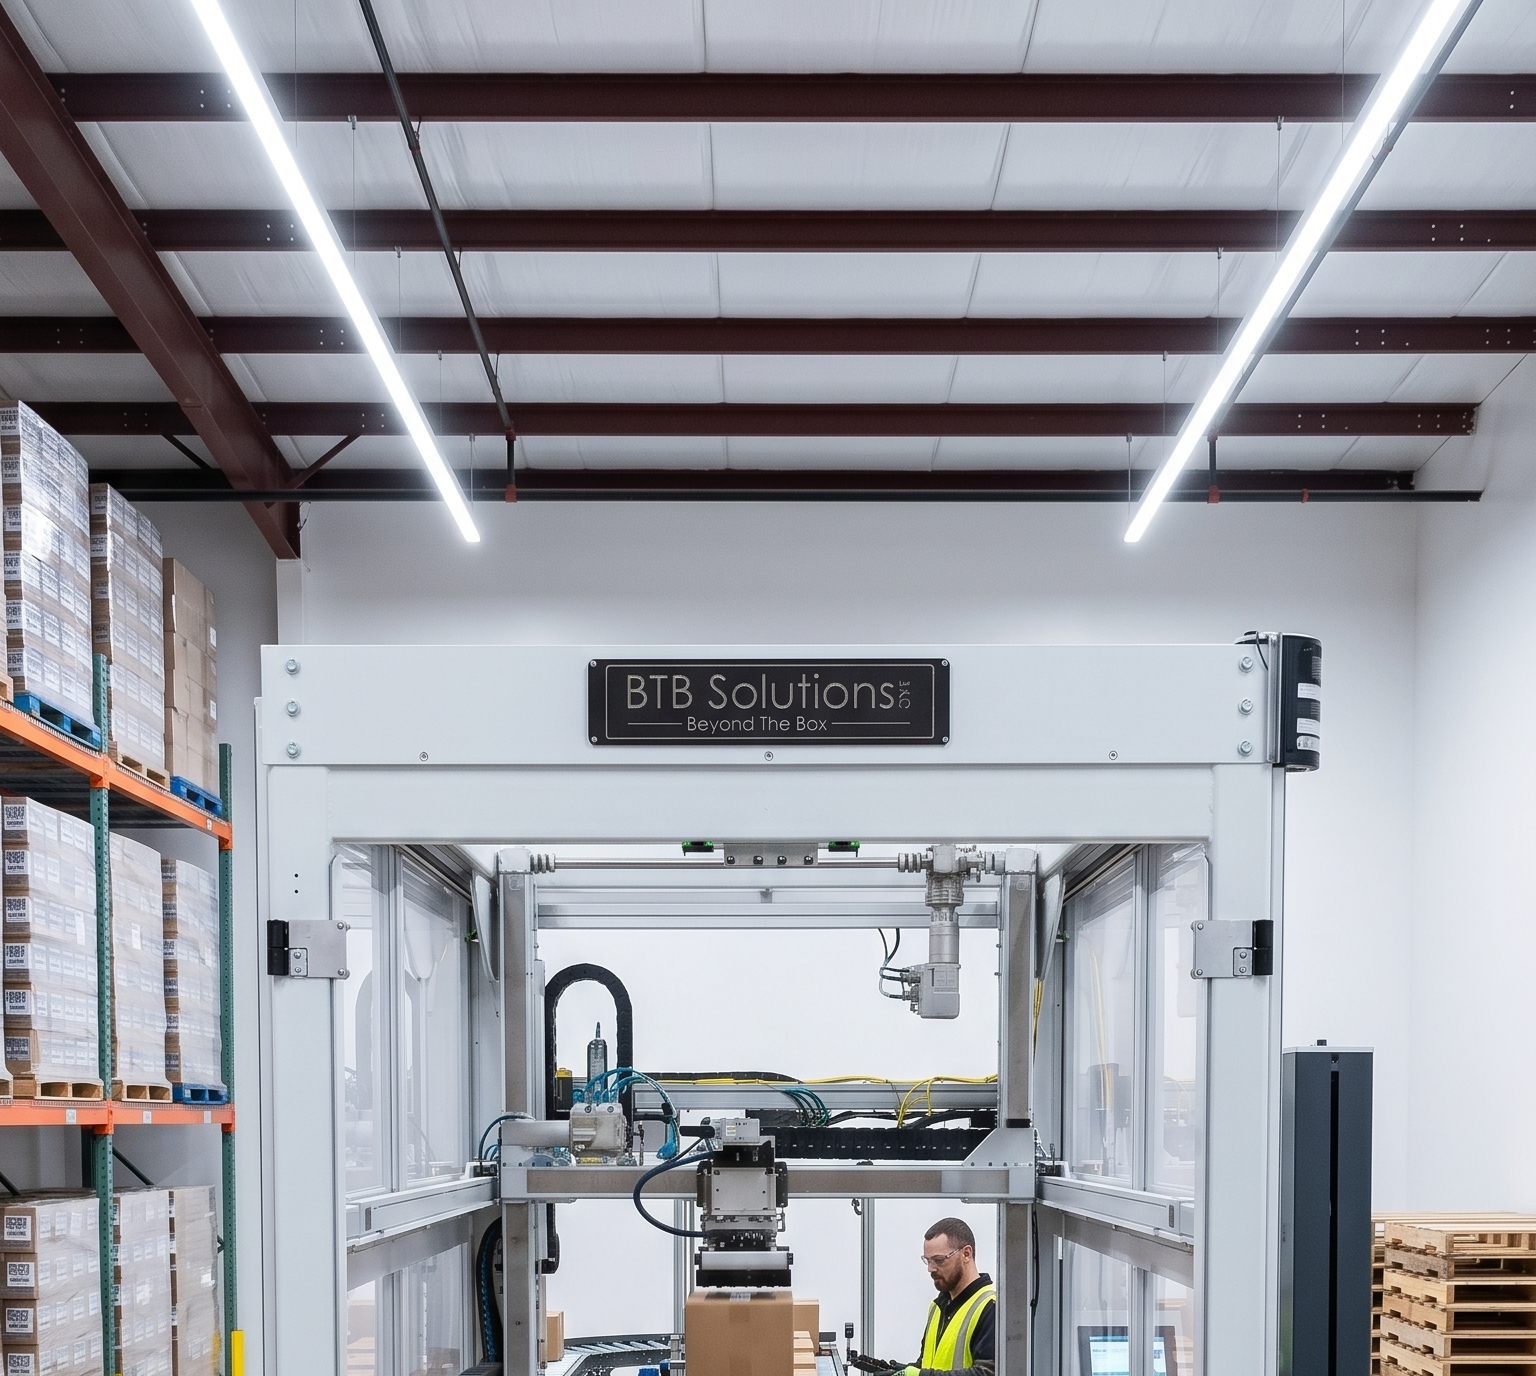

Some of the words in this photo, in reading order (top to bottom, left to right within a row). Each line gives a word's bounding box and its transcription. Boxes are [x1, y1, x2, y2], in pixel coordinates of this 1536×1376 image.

[627, 674, 692, 709] BTB
[708, 673, 895, 710] Solutions
[687, 716, 754, 735] Beyond
[760, 716, 790, 731] The
[796, 716, 828, 731] Box
